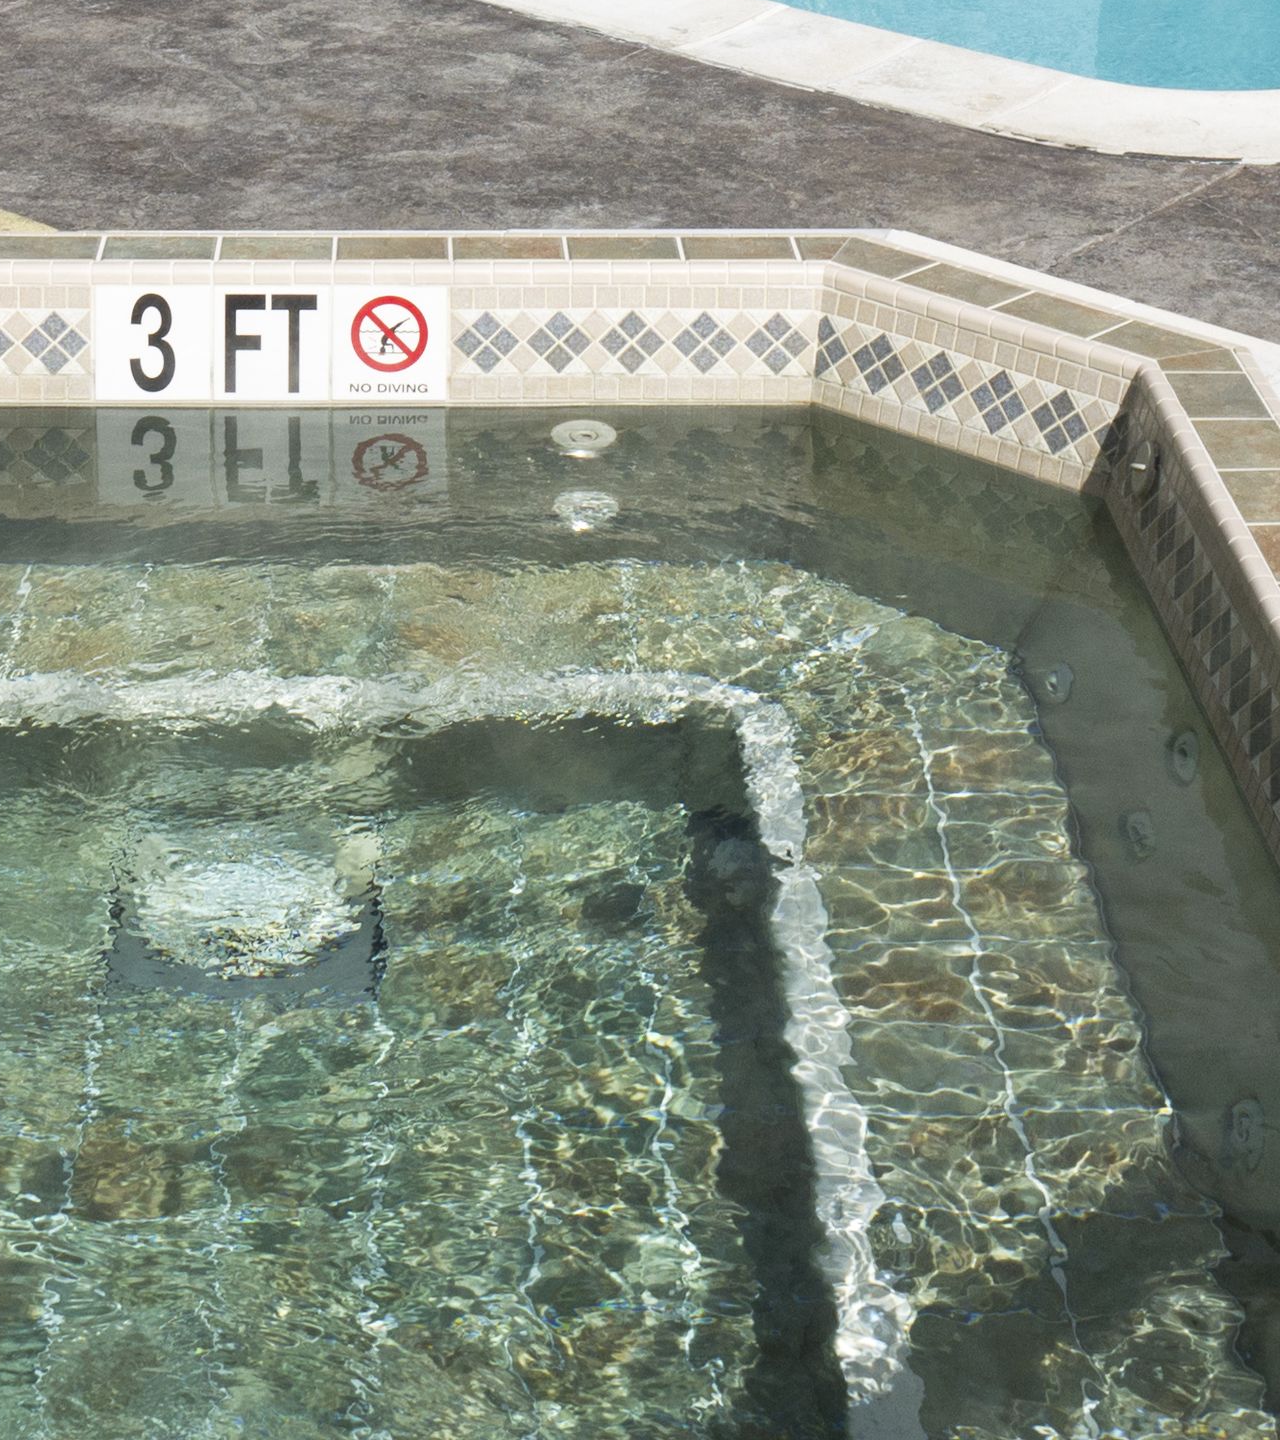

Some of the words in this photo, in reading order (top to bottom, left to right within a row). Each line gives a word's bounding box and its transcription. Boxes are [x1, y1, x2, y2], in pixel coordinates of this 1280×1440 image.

[129, 293, 176, 393] 3
[224, 294, 318, 393] FT
[349, 383, 372, 393] NO
[377, 383, 428, 393] DIVING
